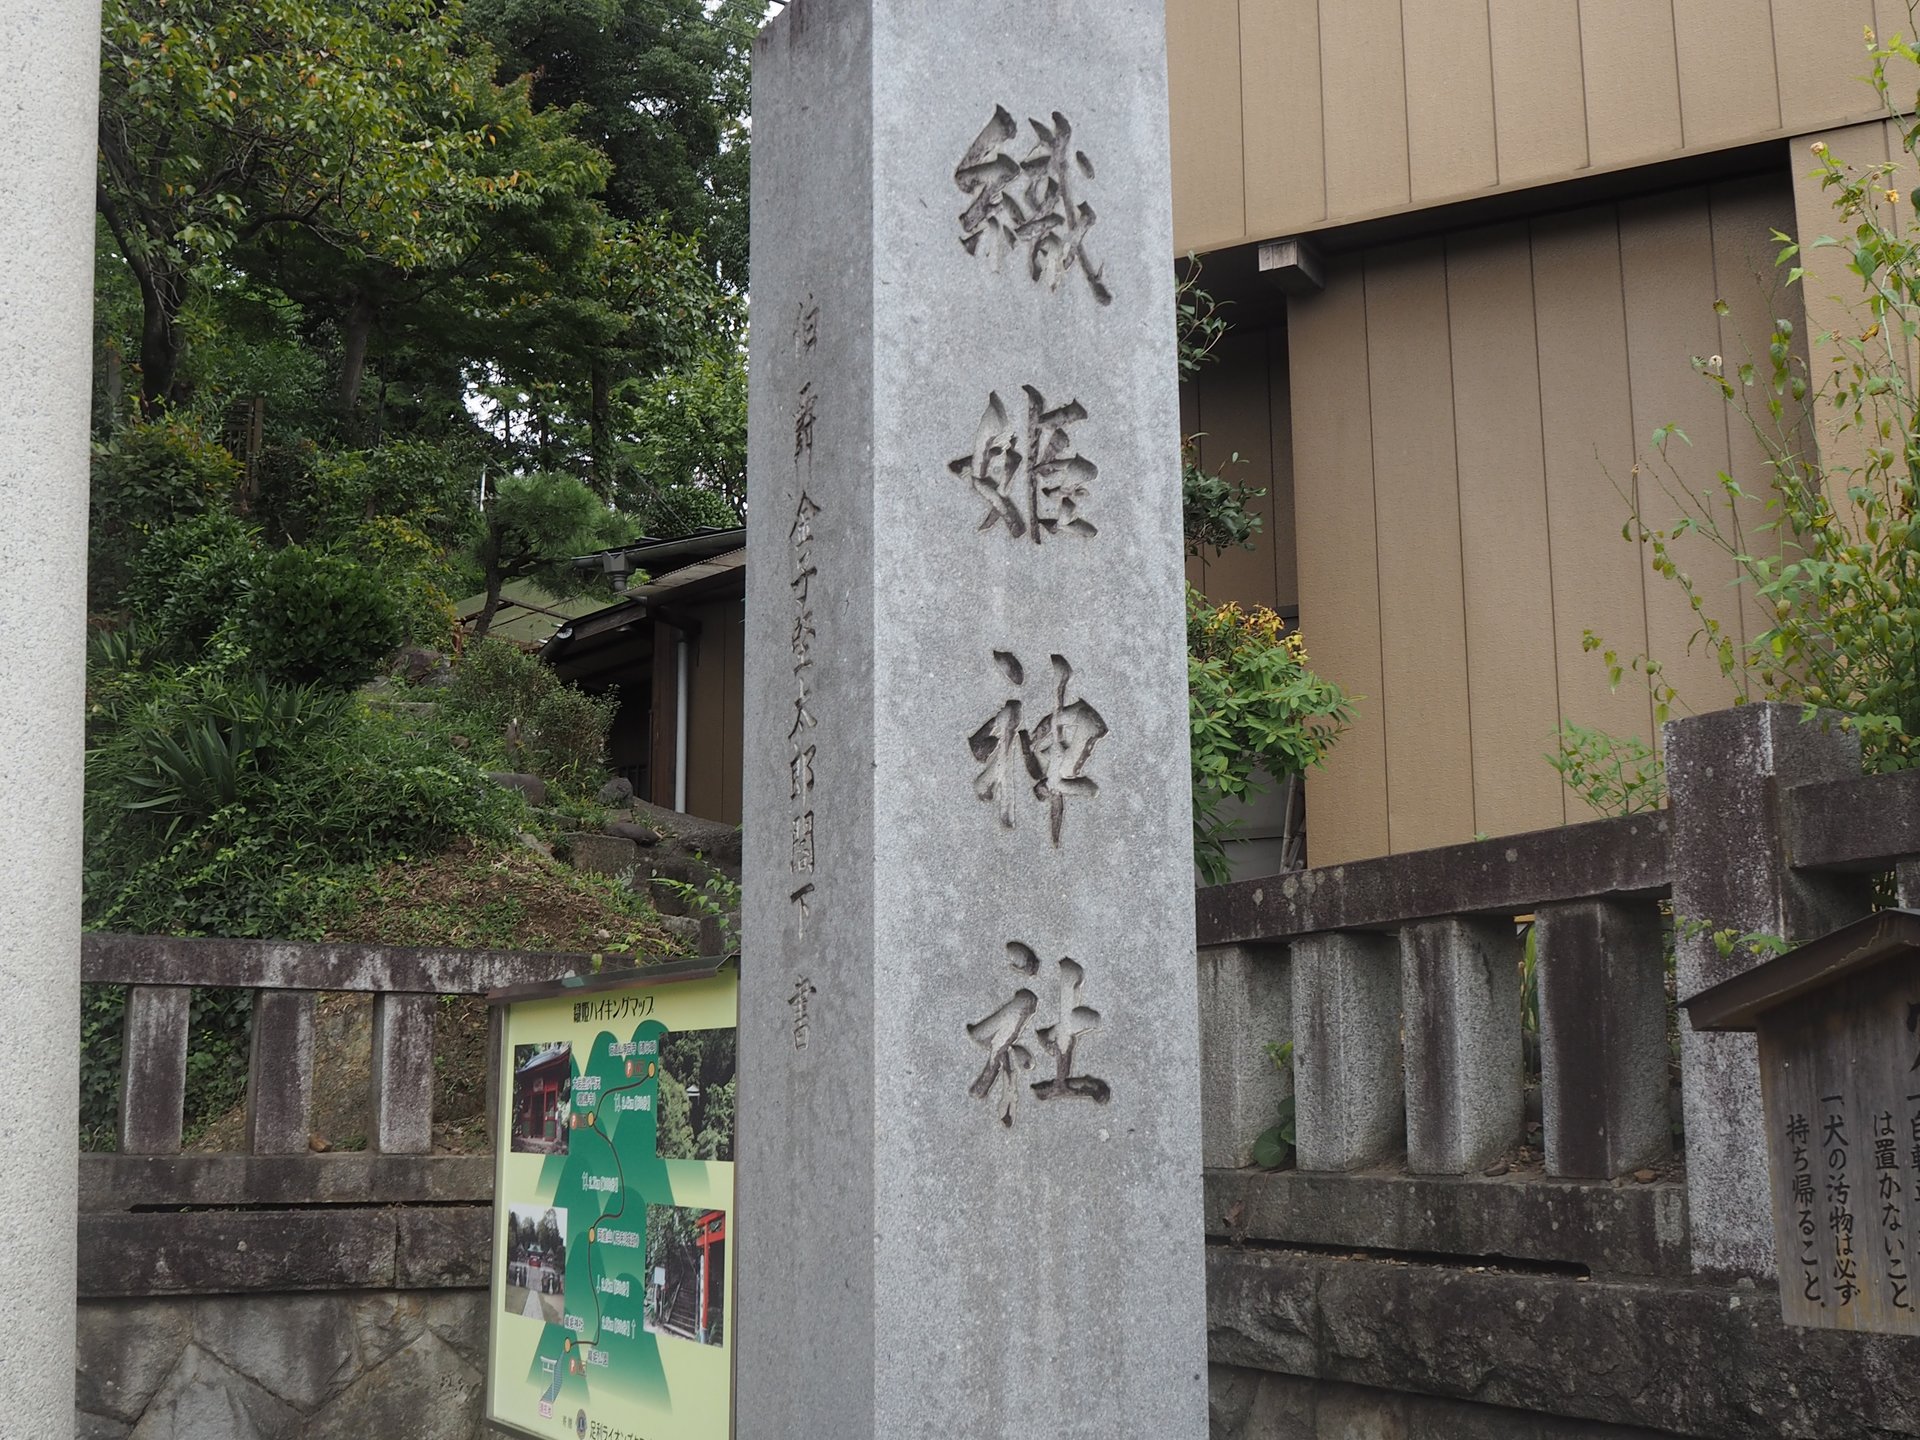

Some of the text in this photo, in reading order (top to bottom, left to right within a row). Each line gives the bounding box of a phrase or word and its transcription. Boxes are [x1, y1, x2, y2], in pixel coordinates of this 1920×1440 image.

[947, 104, 1110, 1128] 織姫神社
[1873, 1110, 1916, 1313] は置かないこと。
